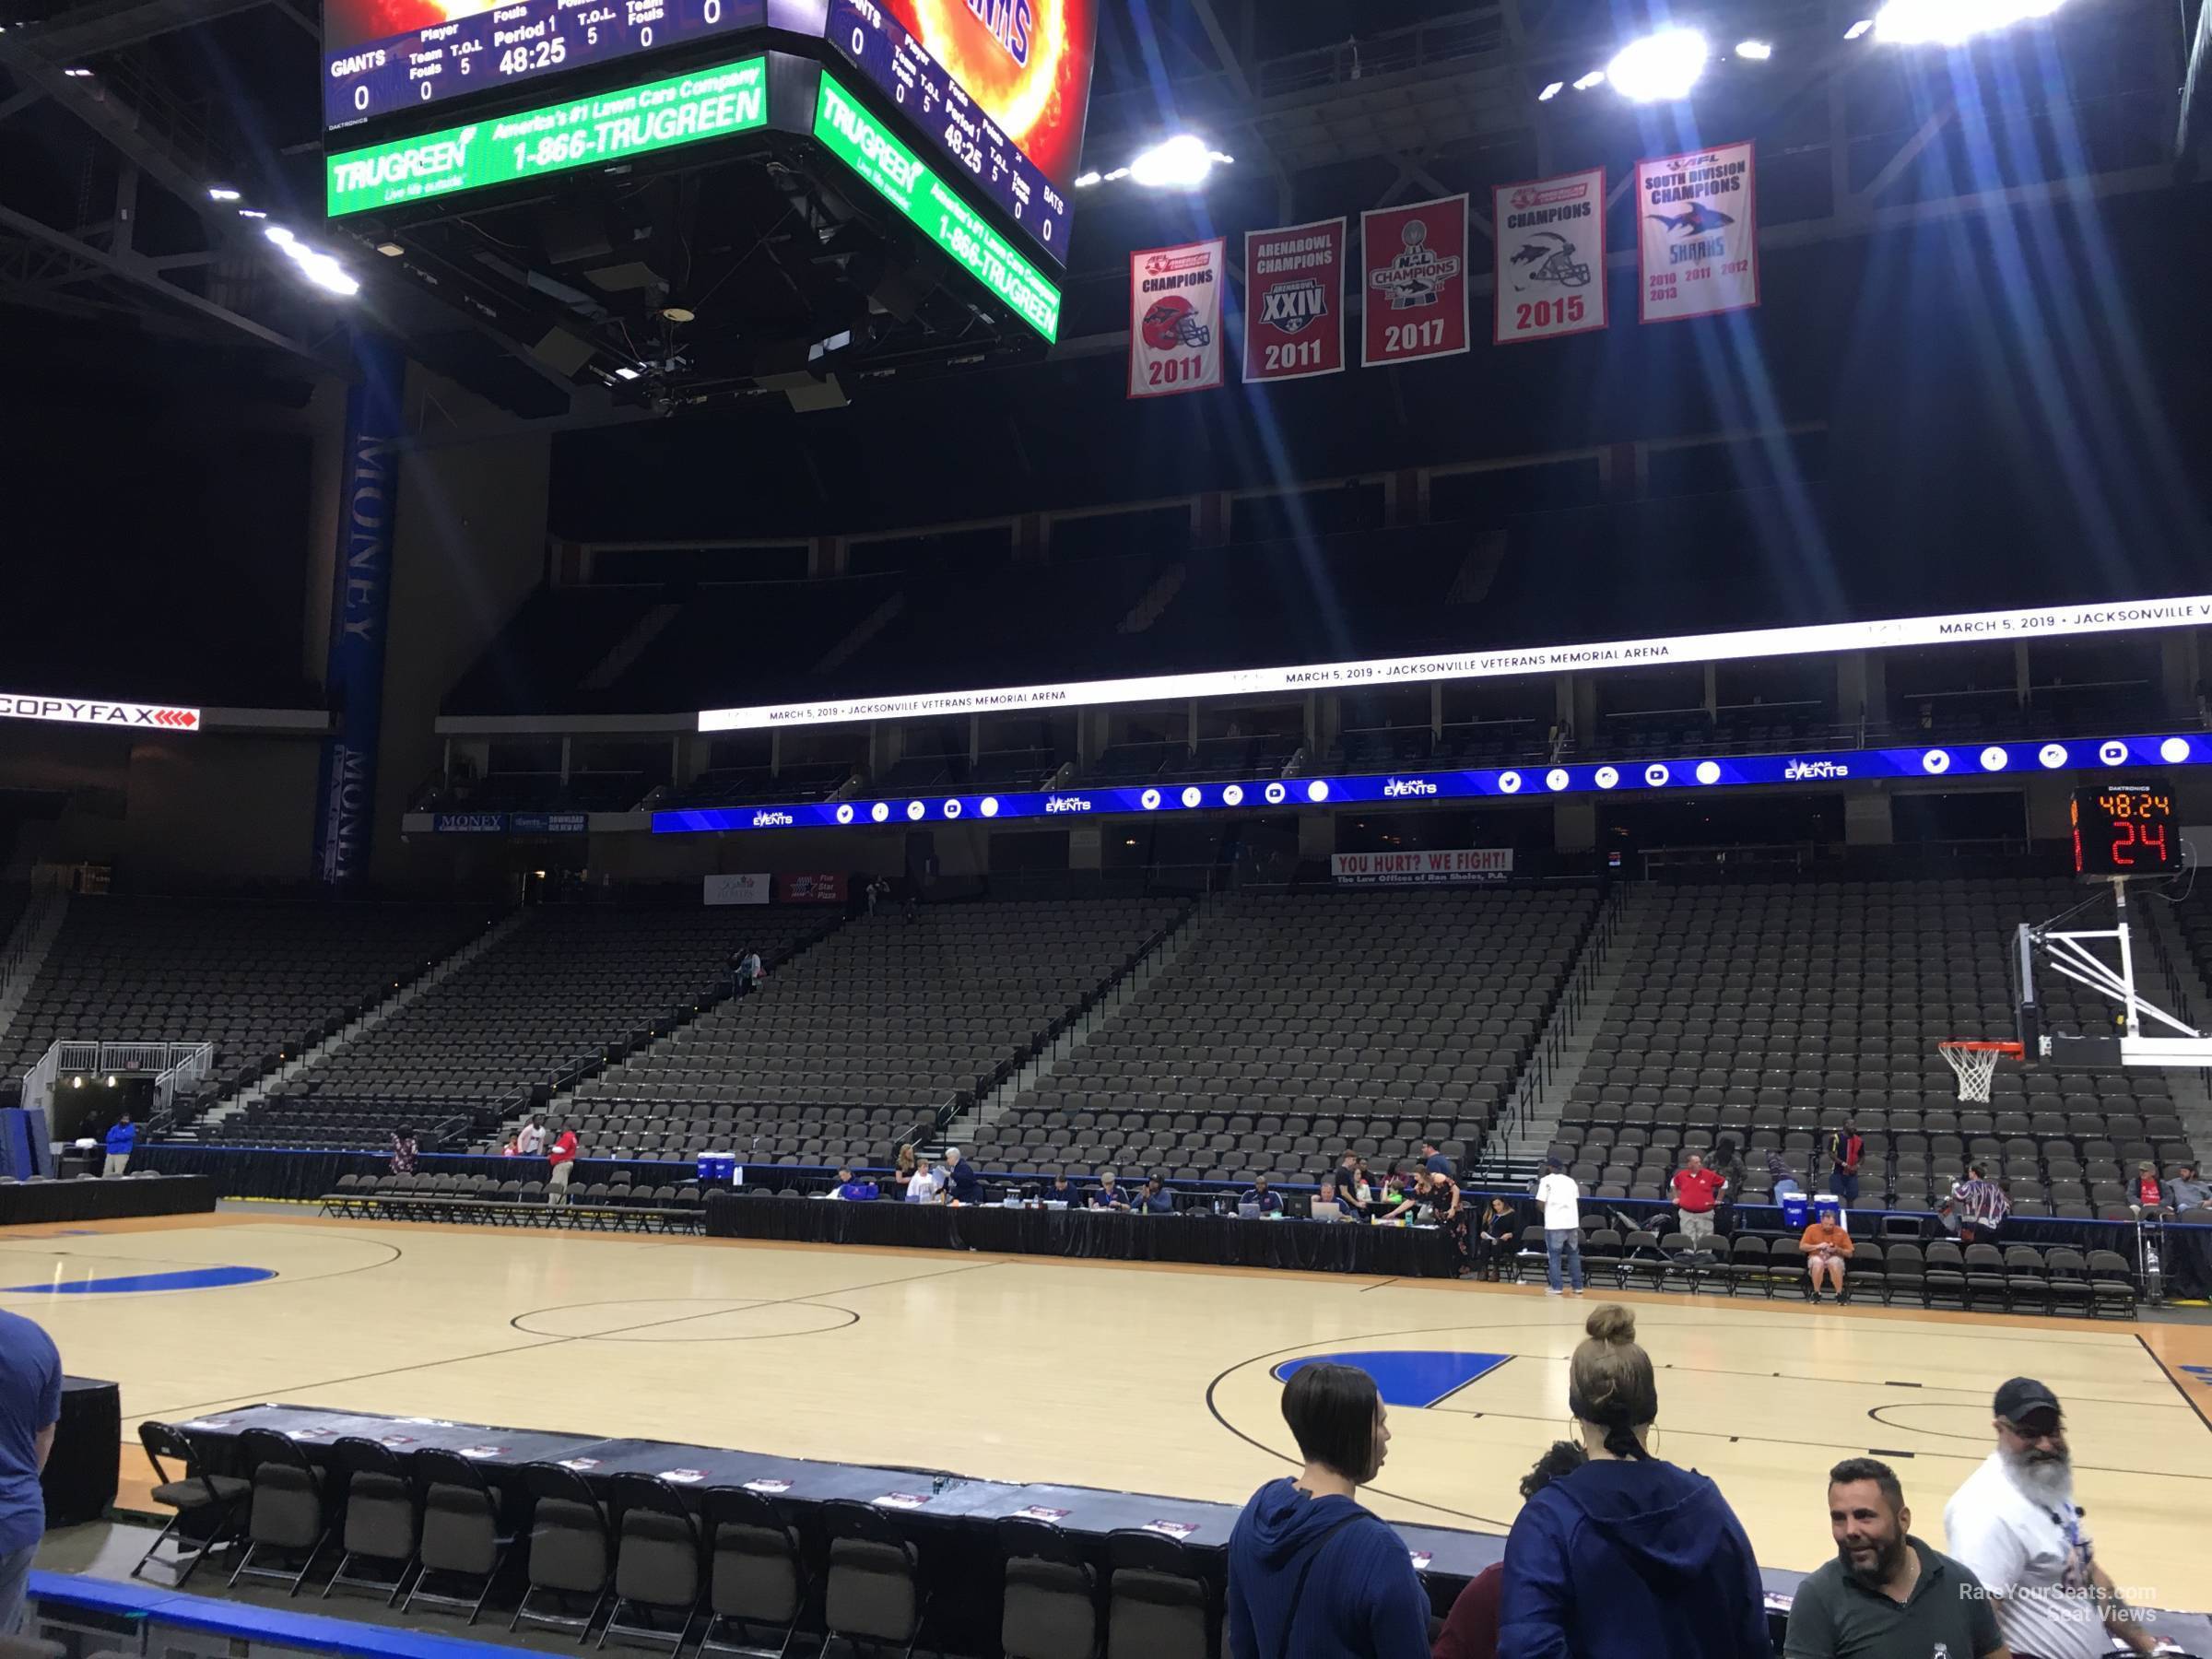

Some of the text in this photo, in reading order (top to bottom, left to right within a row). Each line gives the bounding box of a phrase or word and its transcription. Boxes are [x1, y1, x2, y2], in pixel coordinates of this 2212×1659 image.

[494, 6, 527, 24] Fouls
[578, 7, 617, 26] T.O.L.
[628, 7, 665, 26] Fouls
[704, 0, 720, 24] 0
[420, 22, 459, 42] Player
[494, 15, 556, 47] Period 1
[588, 27, 597, 44] 5
[641, 27, 653, 46] 0
[852, 27, 864, 54] 0
[409, 48, 442, 65] Team
[499, 37, 566, 76] 48:25
[905, 33, 929, 65] Player
[331, 49, 386, 77] GIANTS
[409, 62, 442, 79] Fouls
[461, 57, 470, 75] 5
[354, 85, 369, 111] 0
[420, 81, 431, 100] 0
[896, 83, 904, 103] 0
[492, 110, 568, 140] America's
[592, 96, 636, 119] Lawn
[680, 66, 761, 100] Company
[924, 96, 931, 112] 5
[328, 117, 368, 131] DAKTRONICS
[512, 87, 761, 171] 1-866-TRUGREEN
[946, 99, 975, 138] Period
[824, 87, 915, 194] TRUGREEN
[944, 124, 982, 173] 48:25
[334, 140, 466, 193] TRUGREEN
[992, 166, 998, 182] 5
[1645, 160, 1746, 190] SOUTH DIVISION
[1043, 185, 1064, 216] BATS
[1652, 175, 1740, 205] CHAMPIONS
[1016, 202, 1021, 219] 0
[1508, 201, 1591, 229] CHAMPIONS
[1043, 219, 1051, 241] 0
[1257, 234, 1333, 258] ARENABOWL
[1669, 236, 1725, 265] SHARKS
[1257, 251, 1333, 275] CHAMPIONS
[1375, 261, 1454, 284] CHAMPIONS
[1650, 259, 1748, 287] 2010 2011 2012
[1143, 269, 1213, 293] CHAMPIONS
[1263, 288, 1323, 322] XXIV
[1650, 288, 1677, 301] 2013
[1516, 295, 1584, 330] 2015
[1384, 319, 1445, 352] 2017
[1265, 339, 1322, 371] 2011
[1148, 355, 1202, 385] 2011
[344, 432, 385, 642] MONEY
[1939, 621, 1996, 634] MARCH
[2003, 619, 2015, 630] 5,
[2021, 616, 2055, 629] 2019
[2074, 605, 2194, 625] JACKSONVILLE
[1286, 645, 1670, 684] MARCH 5, 2019 JACKSONVILLE VETERANS MEMORIAL ARENA
[0, 698, 154, 724] COPYFAX
[770, 711, 804, 721] MARCH
[818, 707, 838, 717] 2019
[848, 700, 918, 714] JACKSONVILLE
[921, 696, 972, 710] VETERANS
[975, 692, 1029, 706] MEMORIAL
[1030, 689, 1066, 702] ARENA
[1784, 763, 1848, 780] EVENTS
[1384, 782, 1438, 796] EVENTS
[1045, 798, 1091, 813] EVENTS
[2100, 794, 2170, 818] 48:24
[442, 815, 502, 827] MONEY
[753, 815, 793, 828] EVENTS
[2112, 820, 2167, 865] 24
[1338, 852, 1506, 873] YOU HURT? WE FIGHT!
[1379, 874, 1412, 883] Offices
